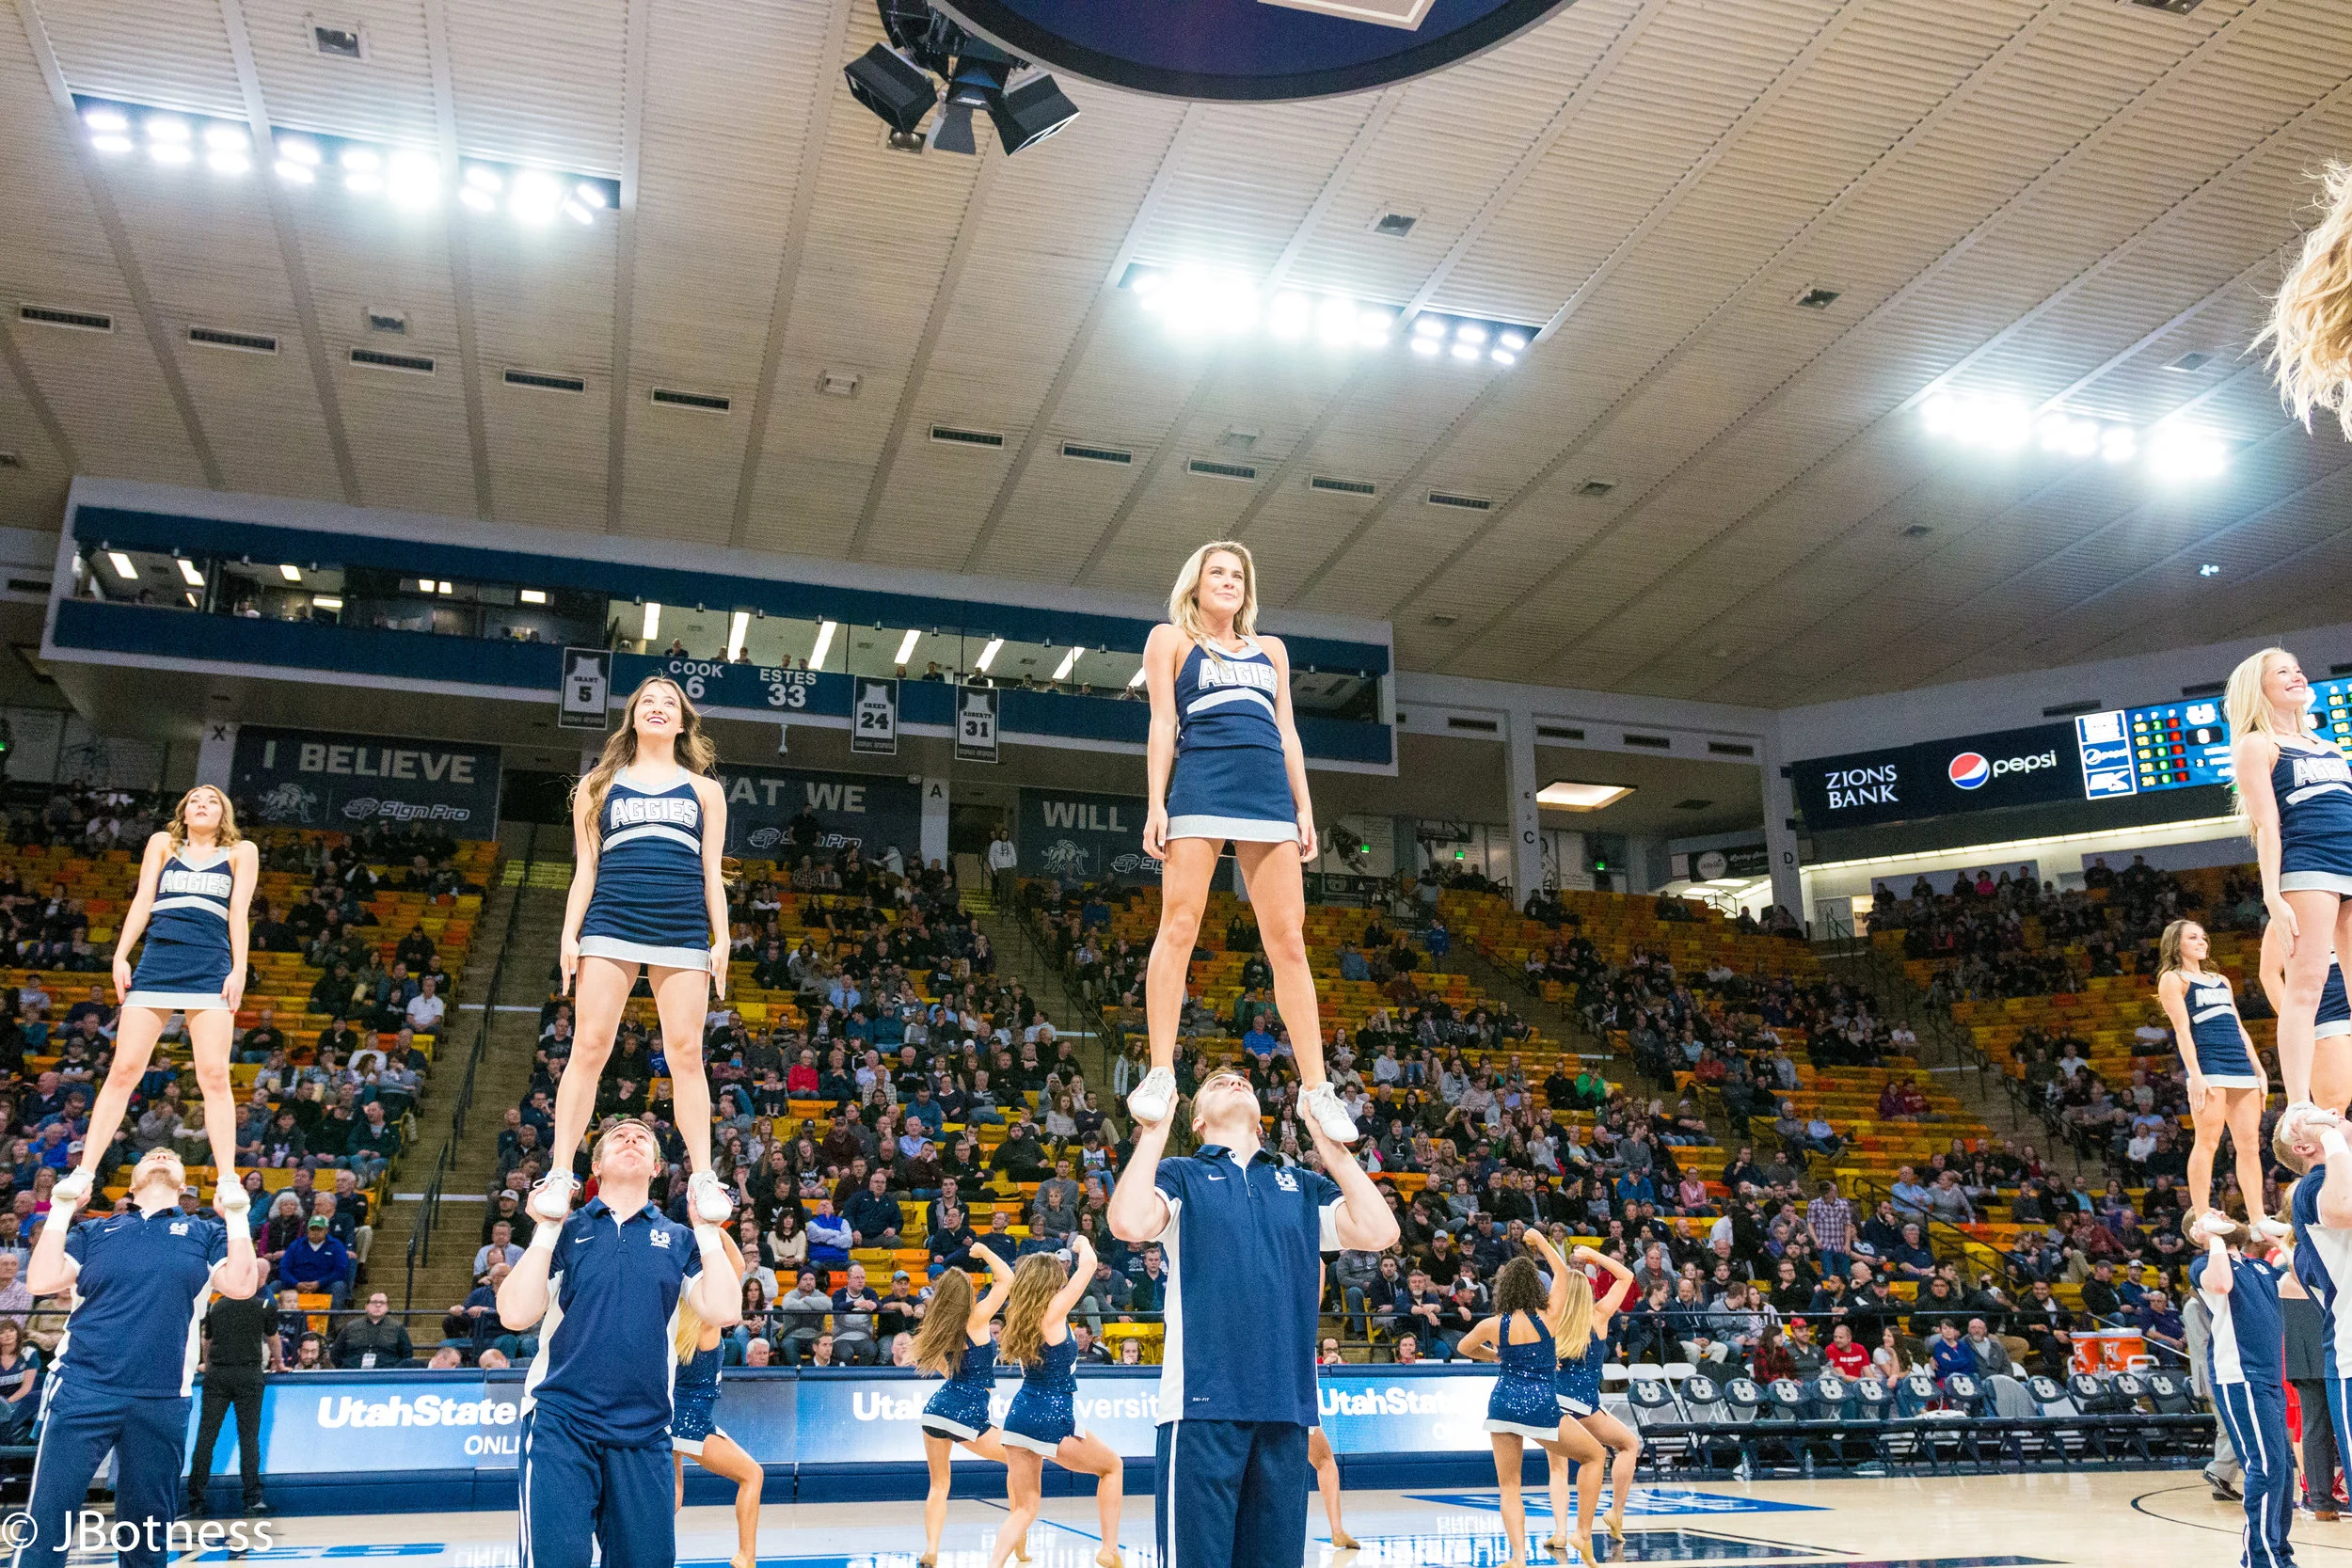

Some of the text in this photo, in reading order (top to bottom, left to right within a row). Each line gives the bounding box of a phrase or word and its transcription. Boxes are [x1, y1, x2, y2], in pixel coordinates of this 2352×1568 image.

[669, 660, 723, 678] COOK
[760, 668, 817, 686] ESTES
[574, 675, 599, 684] GRANT
[686, 675, 705, 699] 6
[579, 686, 592, 702] 5
[768, 683, 805, 707] 33
[861, 712, 889, 730] 24
[963, 711, 992, 720] ROBERTS
[213, 724, 226, 740] X
[965, 721, 989, 737] 31
[263, 740, 476, 784] I BELIEVE
[1993, 750, 2057, 778] pepsi
[1825, 765, 1898, 790] ZIONS
[806, 782, 866, 813] WE
[930, 784, 943, 798] A
[1828, 784, 1899, 809] BANK
[378, 800, 429, 821] Sign
[429, 804, 470, 821] Pro
[611, 798, 698, 830] AGGIES
[1042, 800, 1128, 832] WILL
[1524, 831, 1534, 845] C
[1783, 851, 1793, 865] D
[159, 869, 232, 898] AGGIES
[1076, 1391, 1159, 1418] versit
[465, 1435, 518, 1455] ONLI
